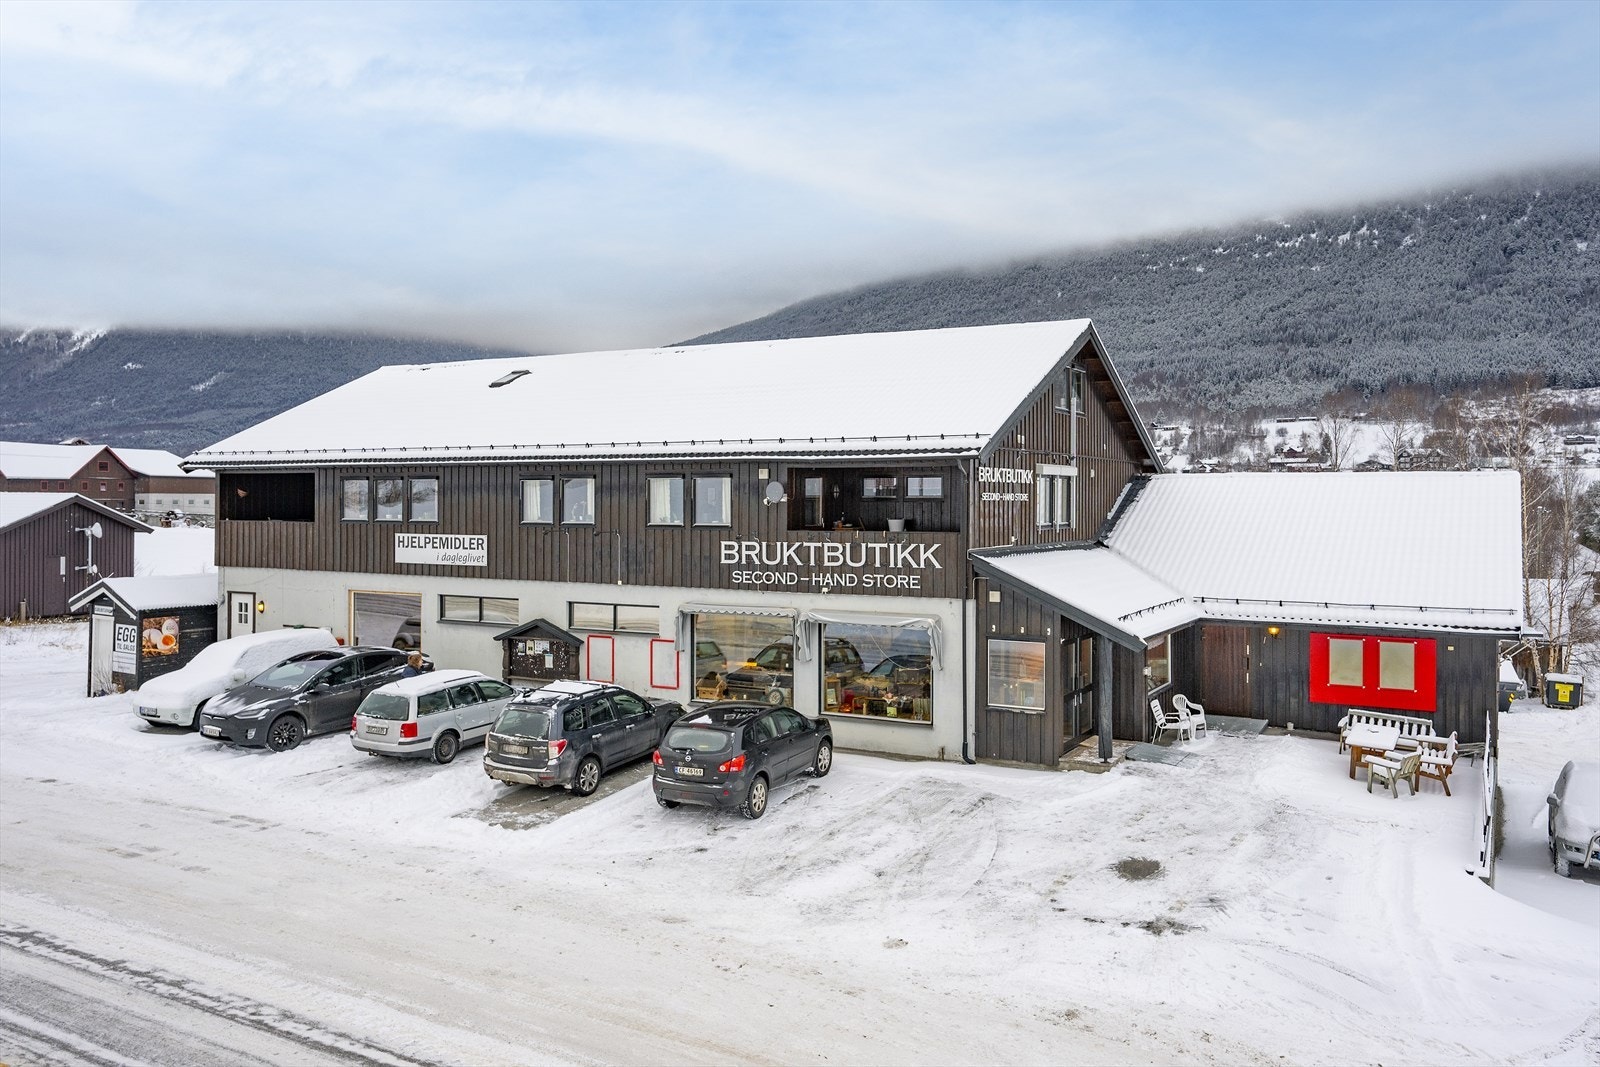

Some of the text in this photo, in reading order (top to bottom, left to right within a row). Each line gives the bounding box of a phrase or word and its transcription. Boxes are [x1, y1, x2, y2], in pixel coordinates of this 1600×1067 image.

[978, 466, 1034, 484] BRUKTBUTIKK
[1015, 494, 1028, 502] STORE
[397, 535, 485, 550] HJELPEMIDLER
[436, 552, 484, 564] i dagleglivet
[720, 540, 943, 569] BRUKTBUTIKK
[862, 574, 921, 589] STORE
[117, 627, 136, 643] EGG
